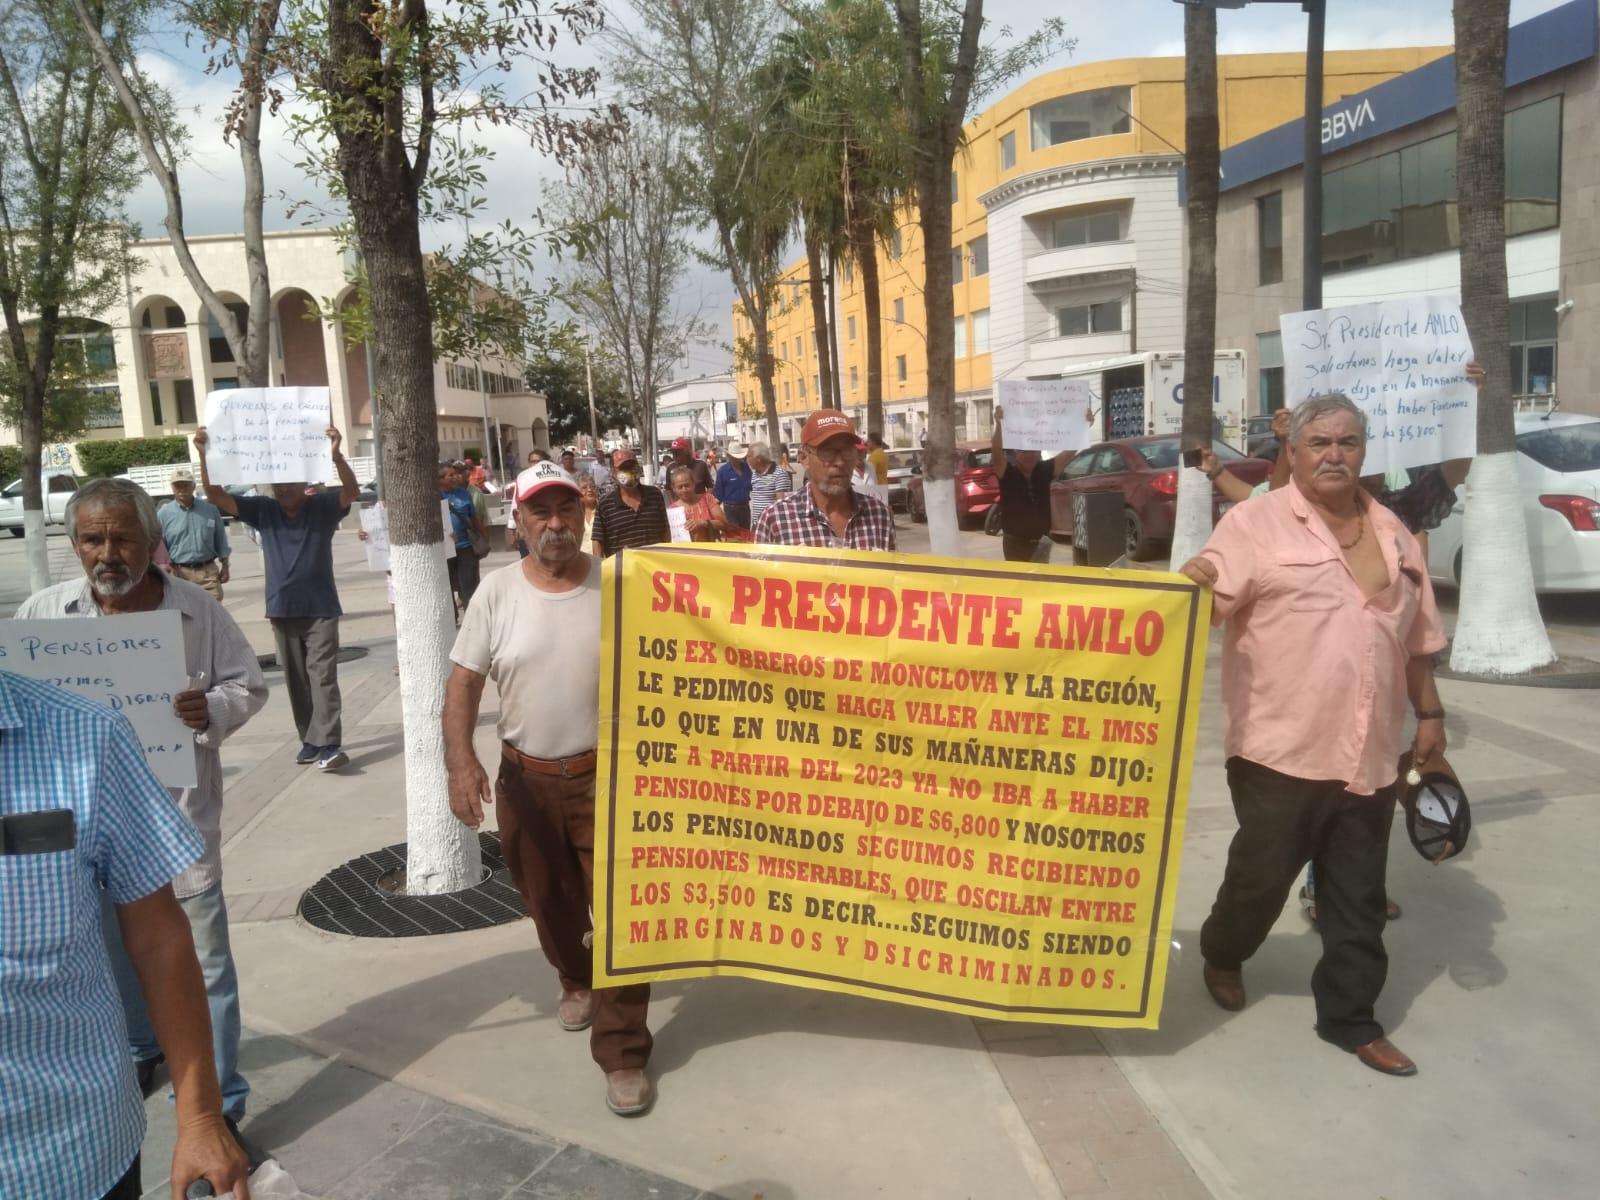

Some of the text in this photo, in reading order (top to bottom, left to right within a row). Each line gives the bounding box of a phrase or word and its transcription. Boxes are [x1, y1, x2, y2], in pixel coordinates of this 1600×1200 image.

[1321, 98, 1375, 144] BBVA
[1329, 311, 1417, 345] Presidente
[1424, 313, 1459, 336] AMLO
[1384, 349, 1418, 373] haga
[1382, 382, 1398, 394] en
[652, 570, 1165, 656] SR. PRESIDENTE AMLO
[638, 635, 1161, 713] LOS EX OBREROS DE MONCLOVA Y LA REGIÓN,
[638, 670, 1159, 746] LE PEDIMOS QUE HAGA VALER ANTE EL IMSS
[636, 705, 1154, 787] LO QUE EN UNA DE SUS MAÑANERAS DIJO:
[636, 740, 1150, 818] QUE A PARTIR DEL 2023 YA NO IBA A HABER
[632, 811, 1141, 889] LOS PENSIONADOS SEGUIMOS RECIBIENDO
[634, 775, 1146, 854] PENSIONES POR DEBAJO DE $6,800 Y NOSOTROS
[630, 882, 671, 906] LOS
[683, 882, 756, 910] $3,500
[767, 889, 793, 913] ES
[1042, 932, 1132, 957] SIENDO
[631, 846, 1136, 923] PENSIONES MISERABLES, QUE OSCILAN ENTRE
[629, 917, 1126, 990] MARGINADOS Y DSICRIMINADOS.
